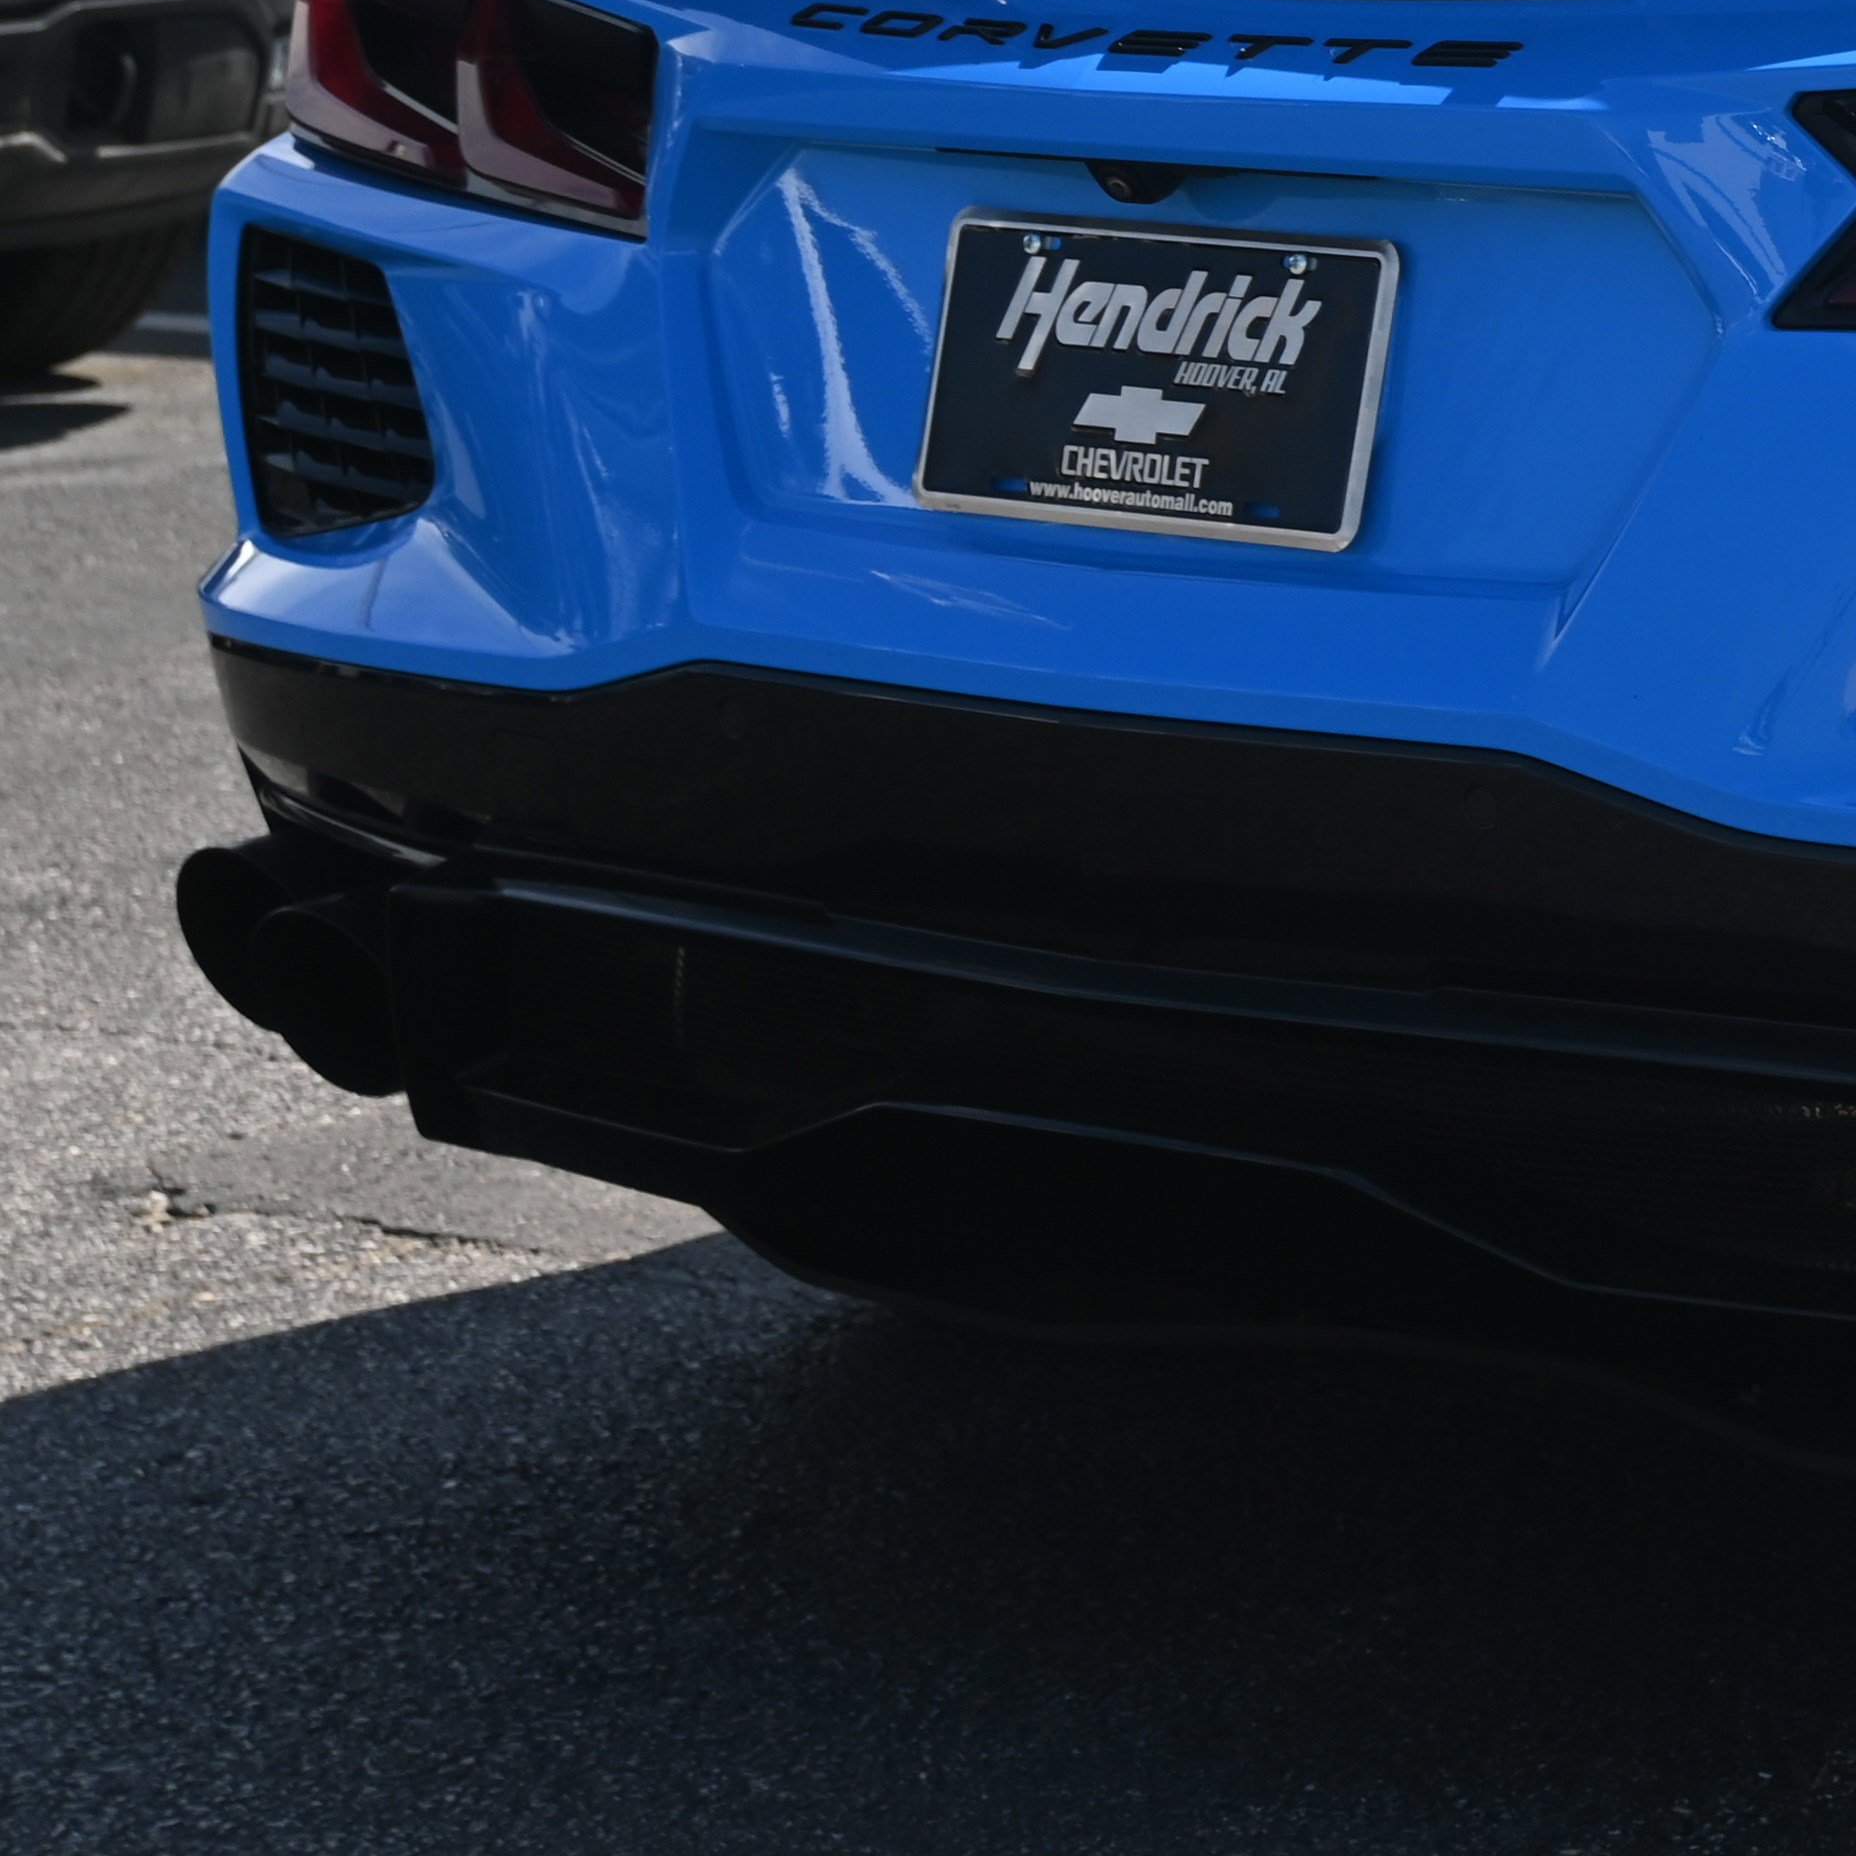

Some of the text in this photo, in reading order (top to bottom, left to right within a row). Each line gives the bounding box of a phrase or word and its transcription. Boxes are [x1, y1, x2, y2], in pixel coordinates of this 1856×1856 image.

[790, 2, 1525, 69] CORVETTE
[995, 255, 1323, 372] Hendrick
[1173, 361, 1287, 395] HOOVER, AL
[1060, 443, 1210, 489] CHEVROLET
[1028, 479, 1234, 518] www.hooverautomall.com
